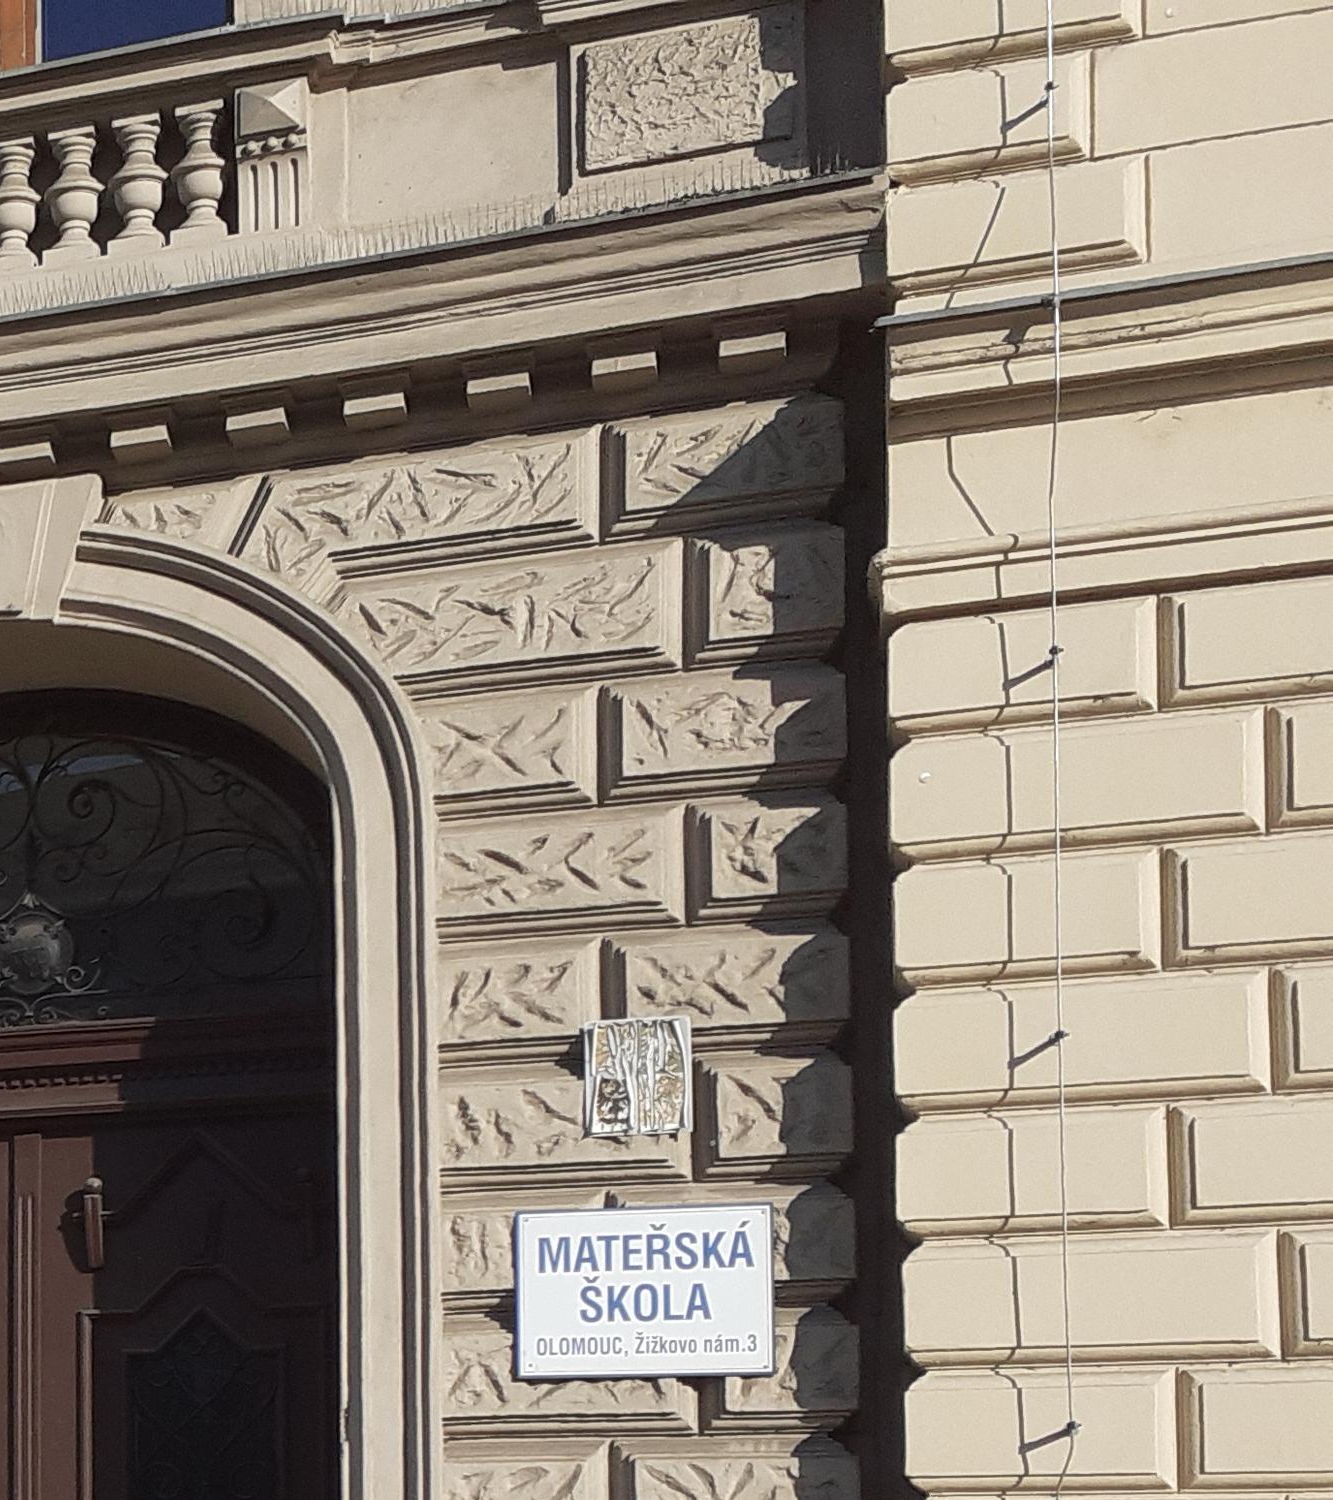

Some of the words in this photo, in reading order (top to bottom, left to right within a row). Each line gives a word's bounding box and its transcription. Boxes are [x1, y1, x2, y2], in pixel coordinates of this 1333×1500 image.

[537, 1220, 755, 1274] MATEŘSKÁ
[579, 1276, 712, 1323] ŠKOLA
[536, 1336, 629, 1357] OLOMOUC,
[634, 1332, 698, 1355] Žižkovo
[703, 1334, 758, 1353] nám.3
